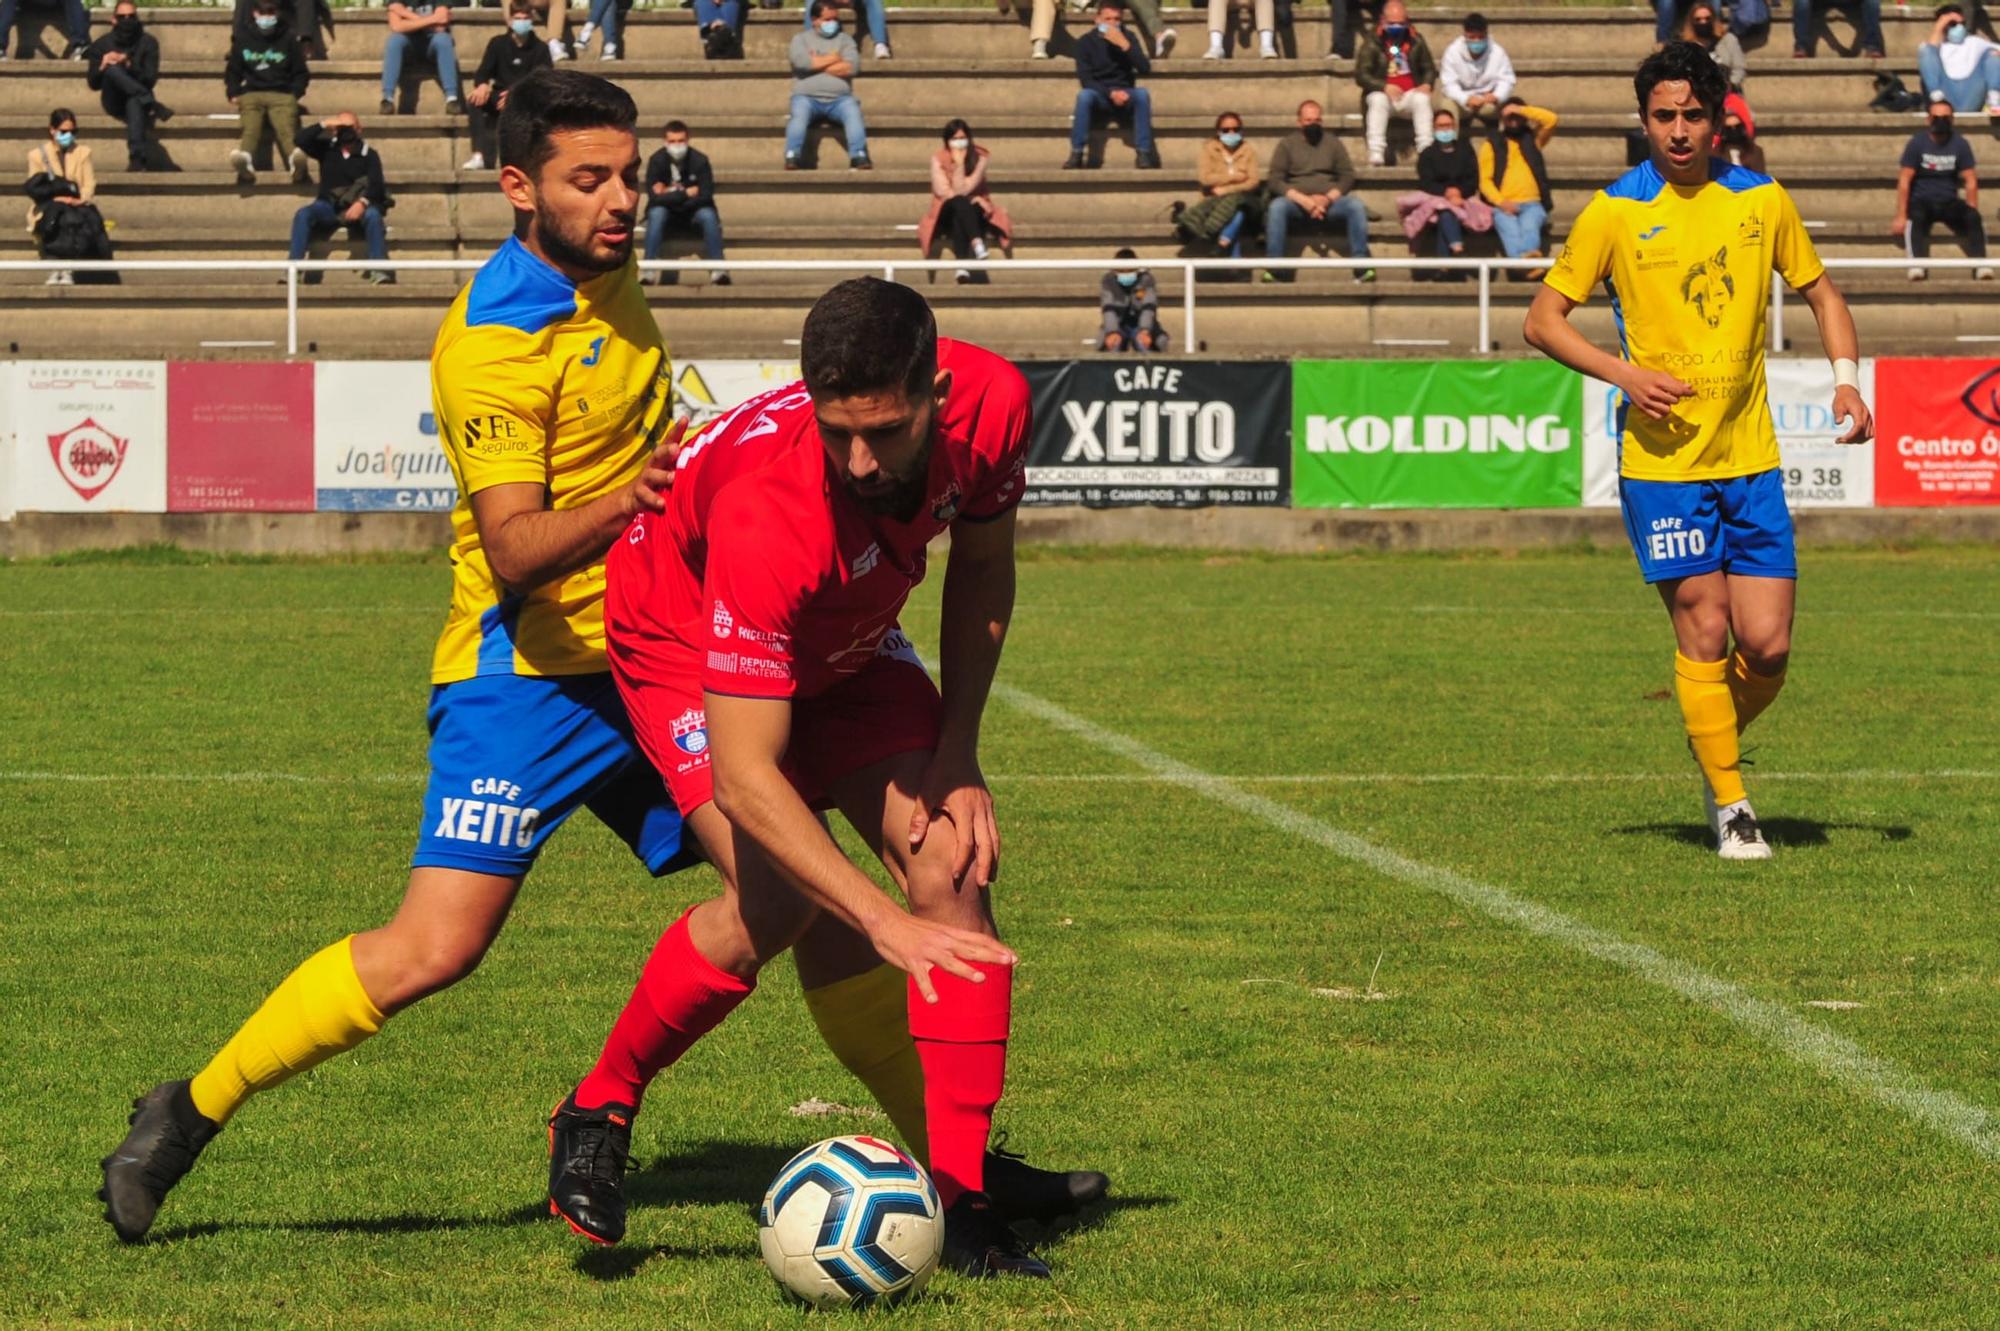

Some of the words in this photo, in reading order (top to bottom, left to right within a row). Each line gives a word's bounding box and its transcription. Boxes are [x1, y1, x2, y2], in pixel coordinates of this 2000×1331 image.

[1114, 365, 1183, 393] CAFE
[1061, 400, 1235, 463] XEITO
[1306, 415, 1570, 453] KOLDING
[1897, 434, 1976, 456] Centro
[1981, 429, 2000, 457] Ó
[481, 440, 529, 456] seguros
[1813, 467, 1843, 487] 38
[395, 489, 459, 507] CAM
[1651, 516, 1683, 532] CAFE
[471, 777, 522, 801] CAFE
[434, 797, 541, 849] XEITO
